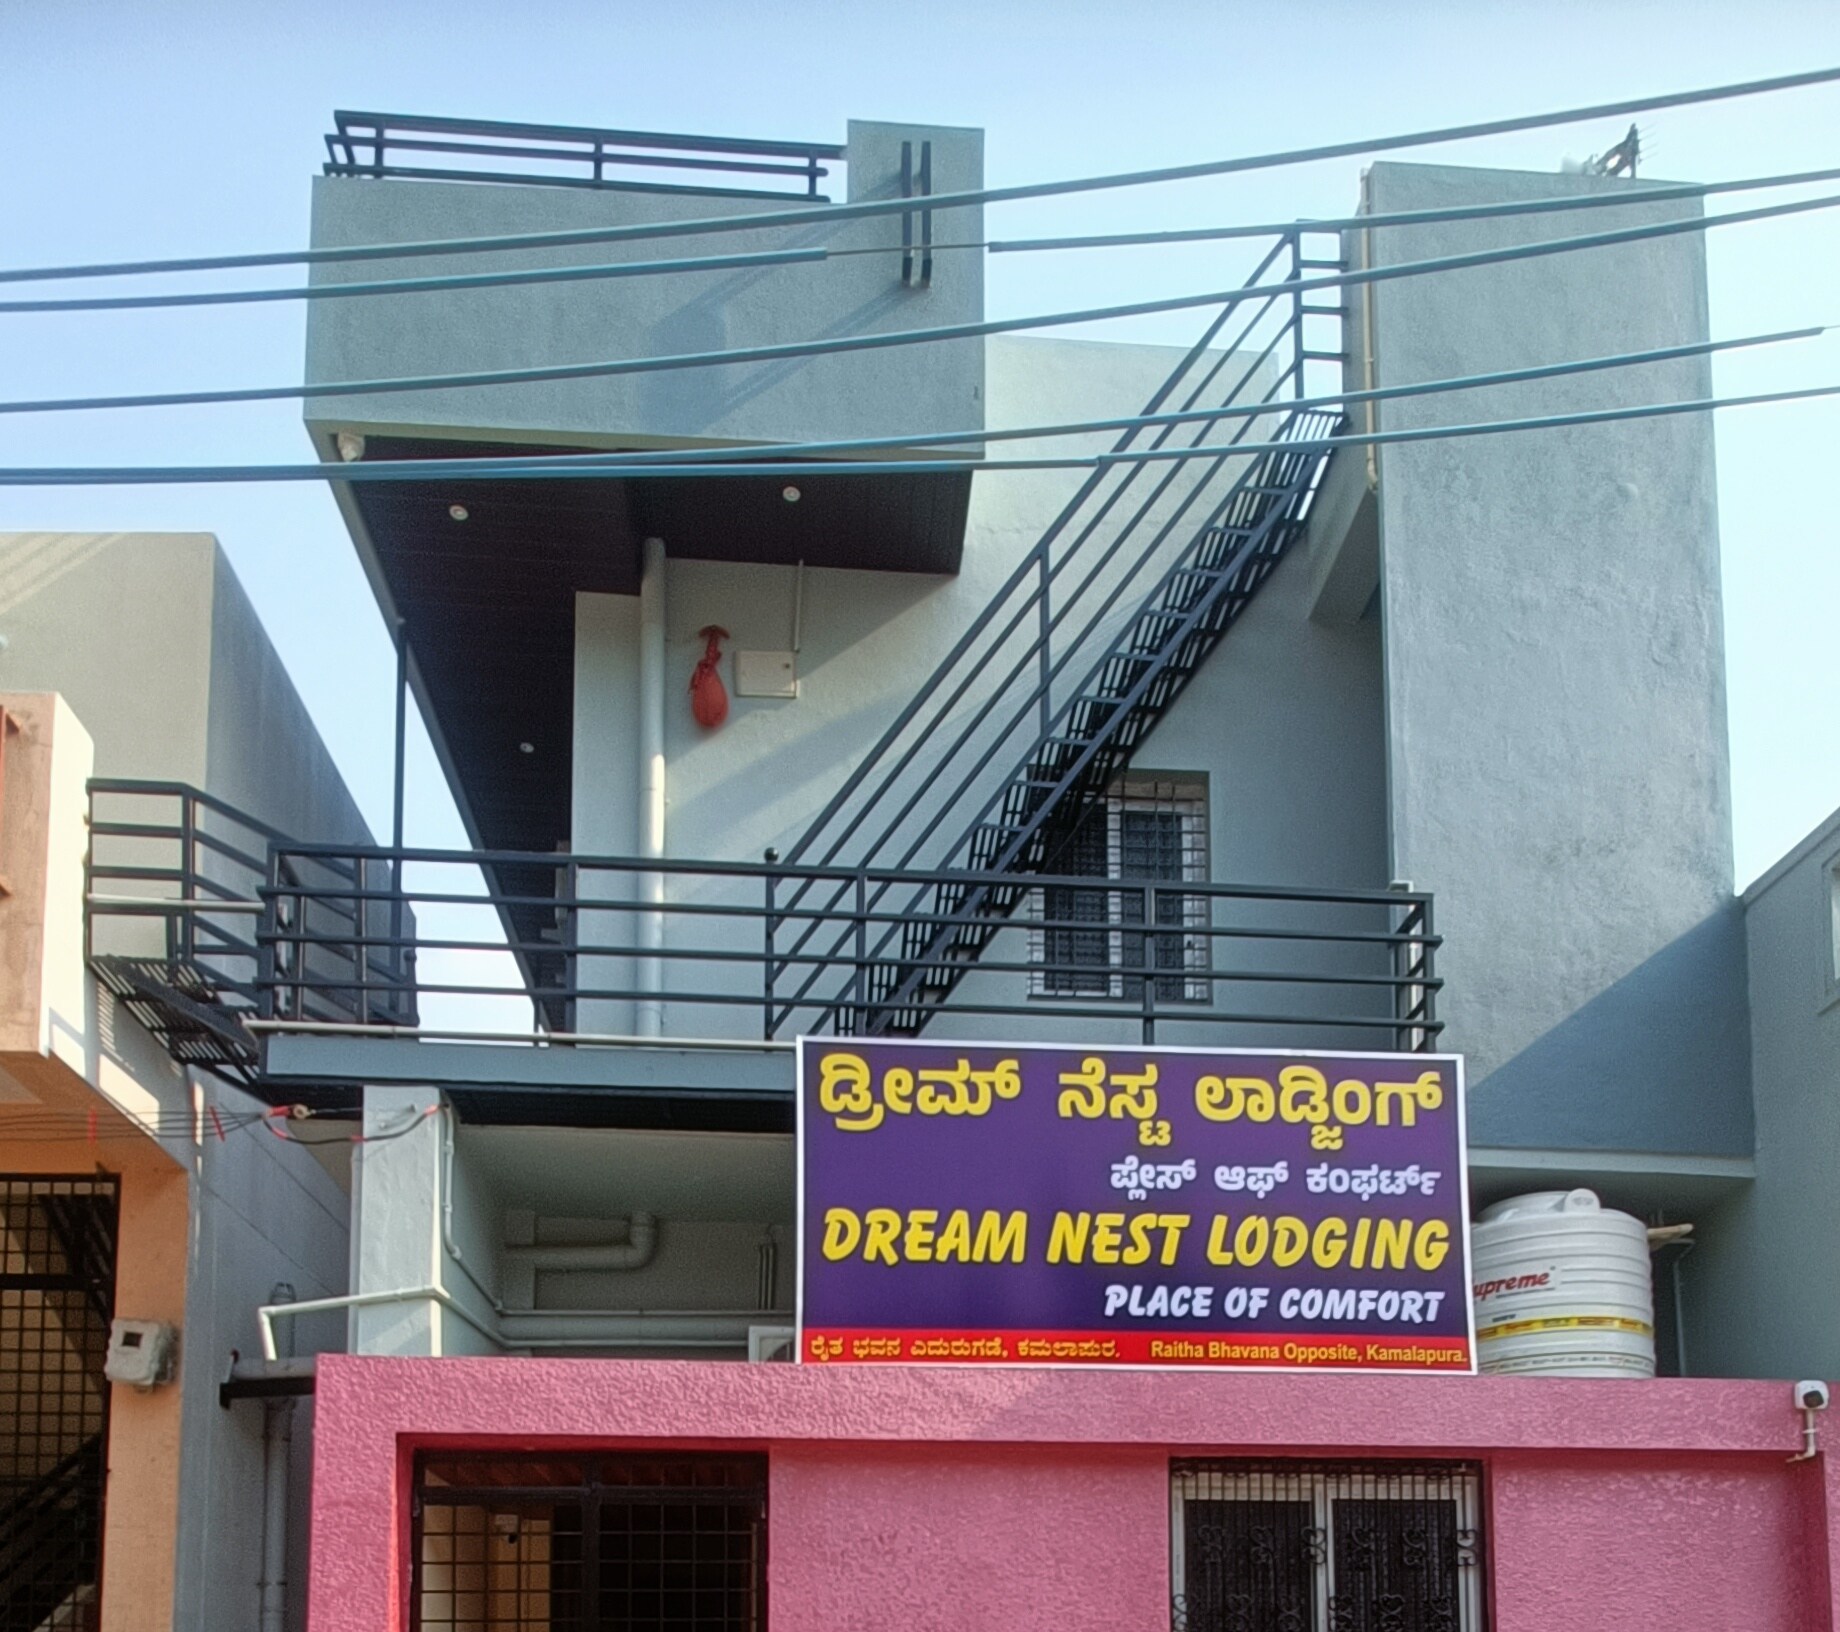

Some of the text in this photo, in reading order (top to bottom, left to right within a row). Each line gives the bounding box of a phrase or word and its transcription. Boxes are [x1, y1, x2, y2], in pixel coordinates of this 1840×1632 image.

[820, 1053, 1442, 1150] ಡ್ರೀಮ್ ನೆಸ್ಟ ಲಾಡ್ಜಿಂಗ್
[1110, 1155, 1197, 1201] ಪ್ಲೇಸ್
[1214, 1161, 1289, 1199] ಆಫ್
[822, 1207, 1449, 1271] DREAM NEST LODGING
[1104, 1285, 1445, 1324] PLACE OF COMFORT
[1473, 1271, 1550, 1301] upreme
[811, 1335, 843, 1361] ರೈತ
[852, 1337, 901, 1358] ಭವನ
[1151, 1341, 1204, 1358] Raitha
[1208, 1342, 1280, 1360] Bhavana
[1283, 1343, 1362, 1363] Opposite,
[1366, 1345, 1468, 1365] Kamalapura.
